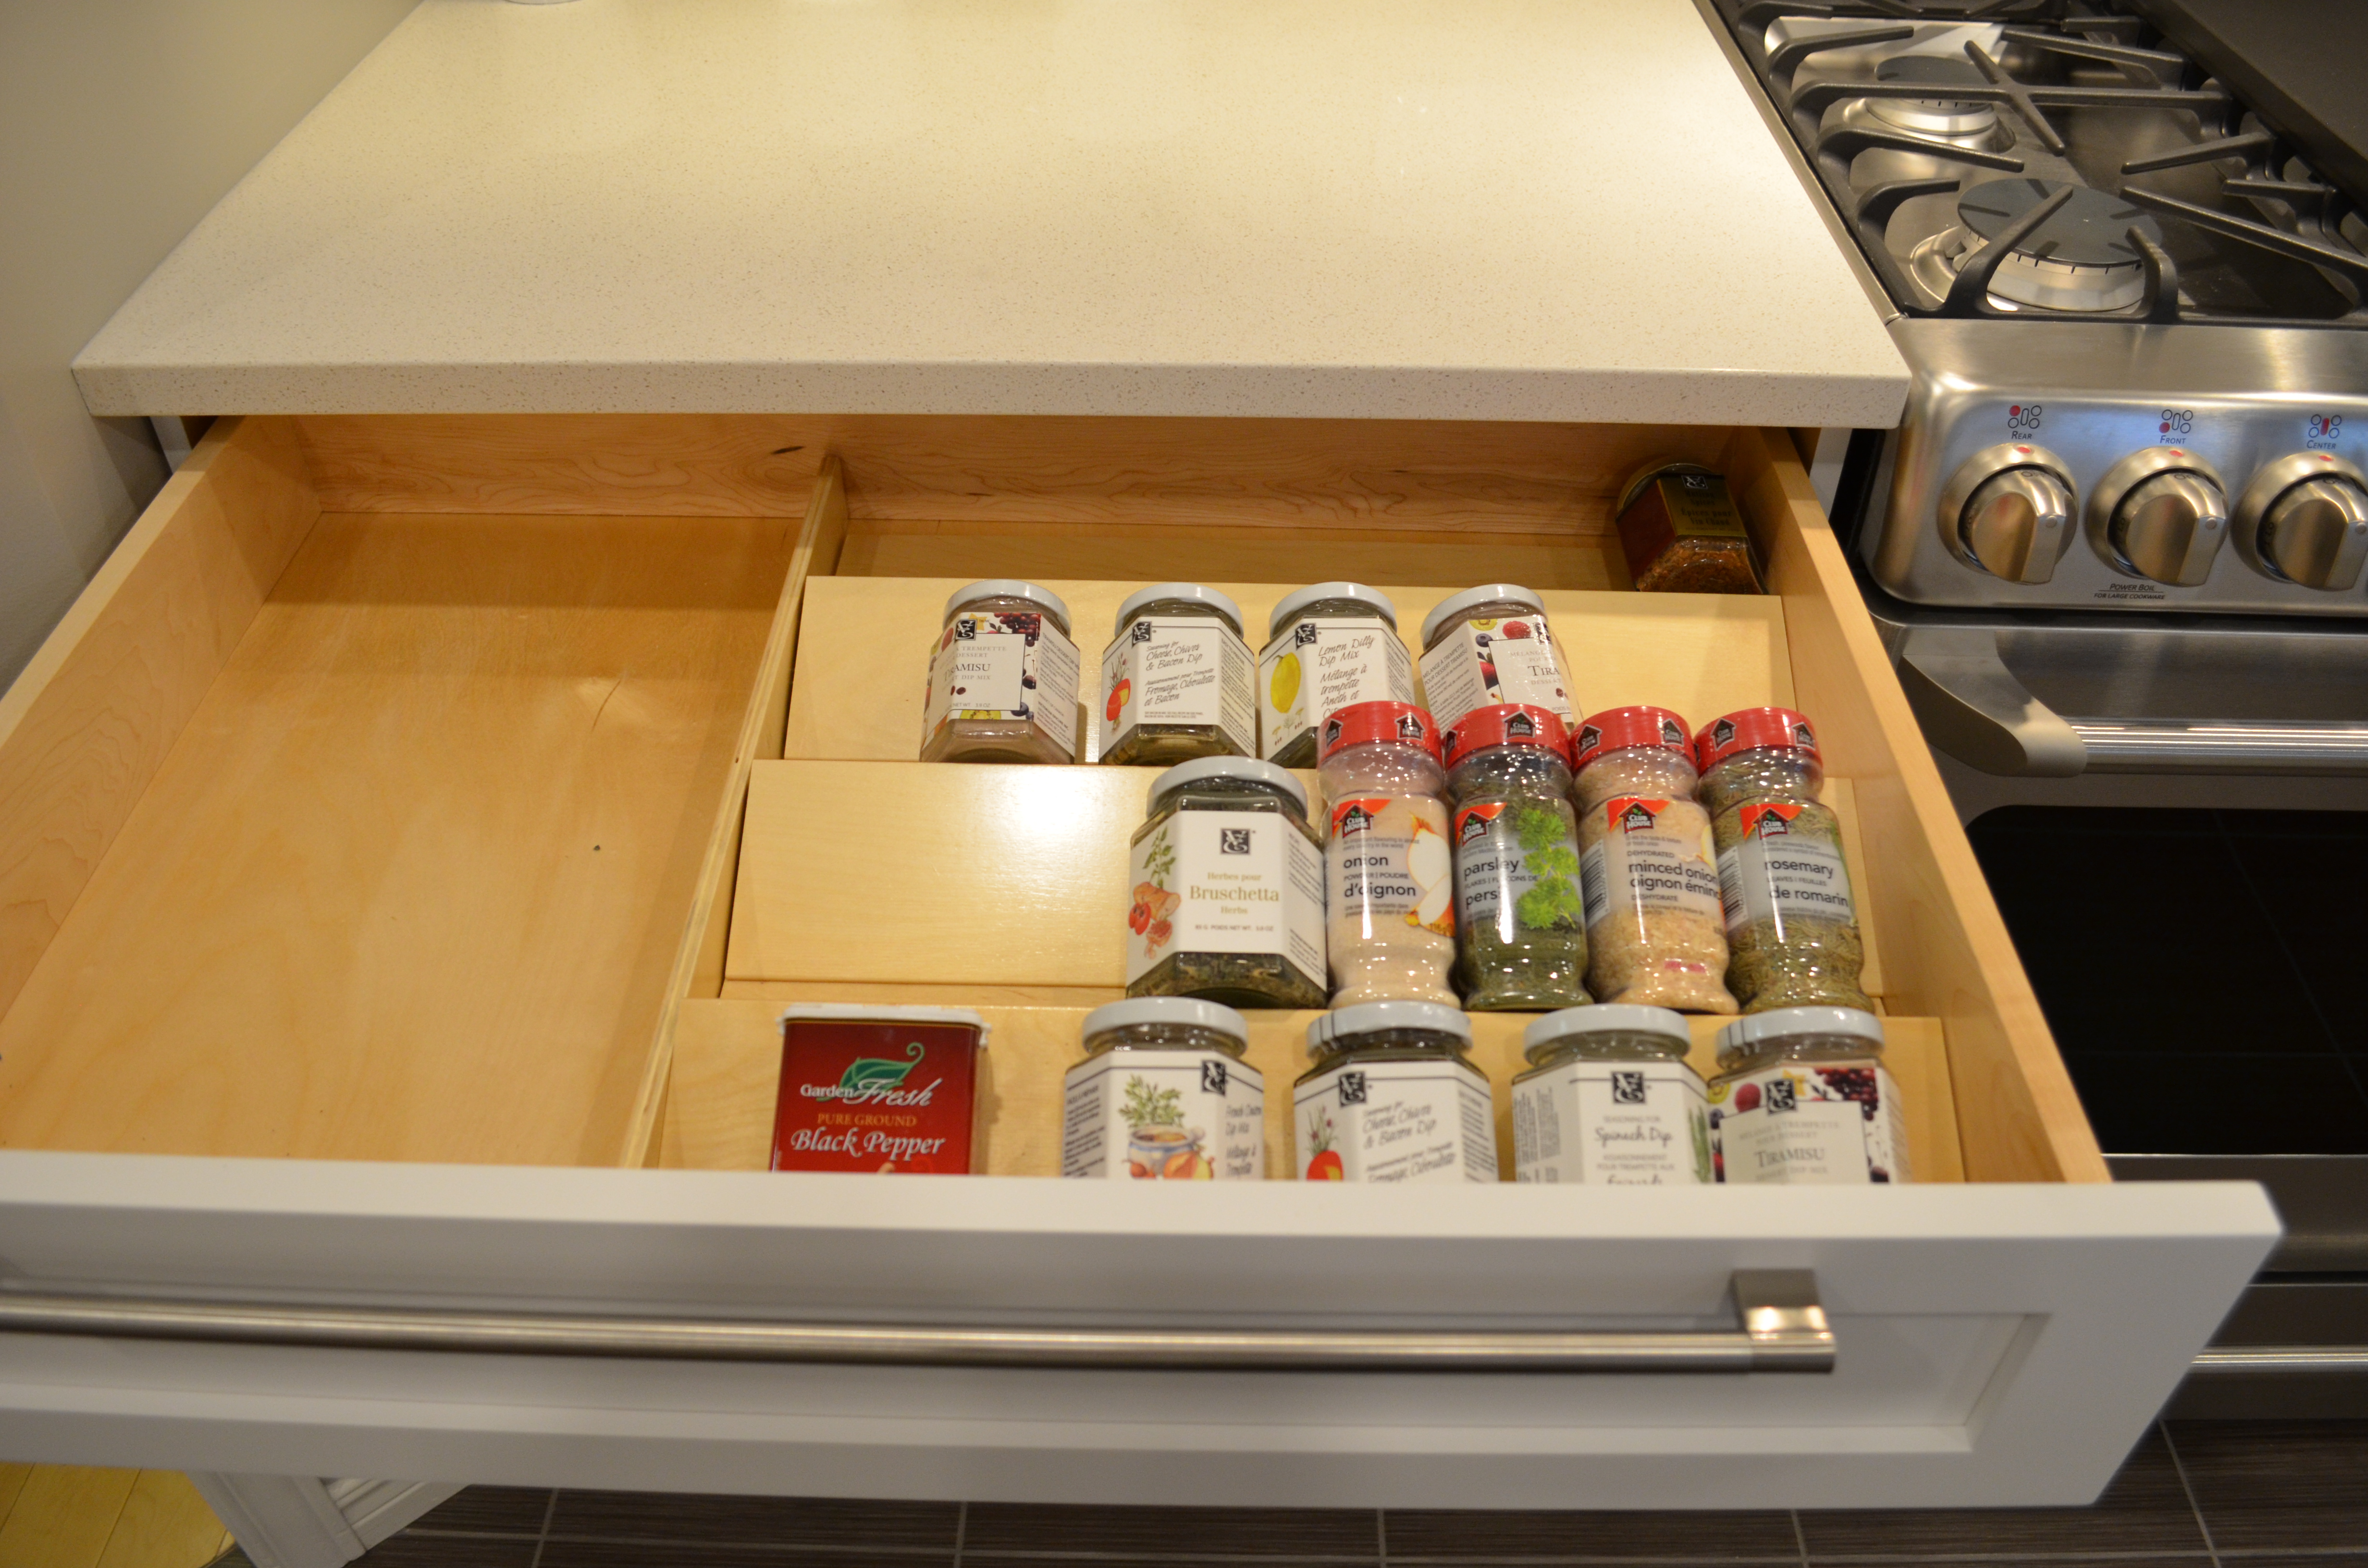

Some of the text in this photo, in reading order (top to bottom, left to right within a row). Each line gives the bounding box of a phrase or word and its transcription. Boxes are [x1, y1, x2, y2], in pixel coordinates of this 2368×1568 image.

[2160, 435, 2186, 444] FRONT
[2307, 440, 2336, 449] CENTER
[1174, 644, 1200, 656] Chives
[1319, 635, 1375, 656] Lemon Dilly
[1146, 653, 1203, 671] & Bacon Dip
[1319, 650, 1360, 668] Dip Mix
[1180, 674, 1215, 689] Ciboulette
[1320, 663, 1367, 683] Mélange à
[1320, 678, 1360, 695] trempette
[1155, 693, 1180, 705] Bacon
[1321, 690, 1360, 707] Aneth et
[1627, 820, 1651, 829] HOUSE
[1627, 850, 1675, 858] DEHYDRATED
[1464, 857, 1519, 881] parsley
[1628, 859, 1683, 876] minced
[1764, 860, 1833, 879] rosemary
[1492, 875, 1527, 883] FLCONS
[1630, 875, 1683, 891] oignon
[1189, 885, 1280, 902] Bruschetta
[1466, 886, 1501, 910] pers
[1795, 890, 1849, 907] romarin
[800, 1078, 943, 1106] Garden Fresh
[818, 1113, 917, 1127] PURE GROUND
[791, 1127, 946, 1161] Black Pepper
[1594, 1125, 1674, 1149] Spinach Dip
[1752, 1147, 1825, 1167] TIRAMISU
